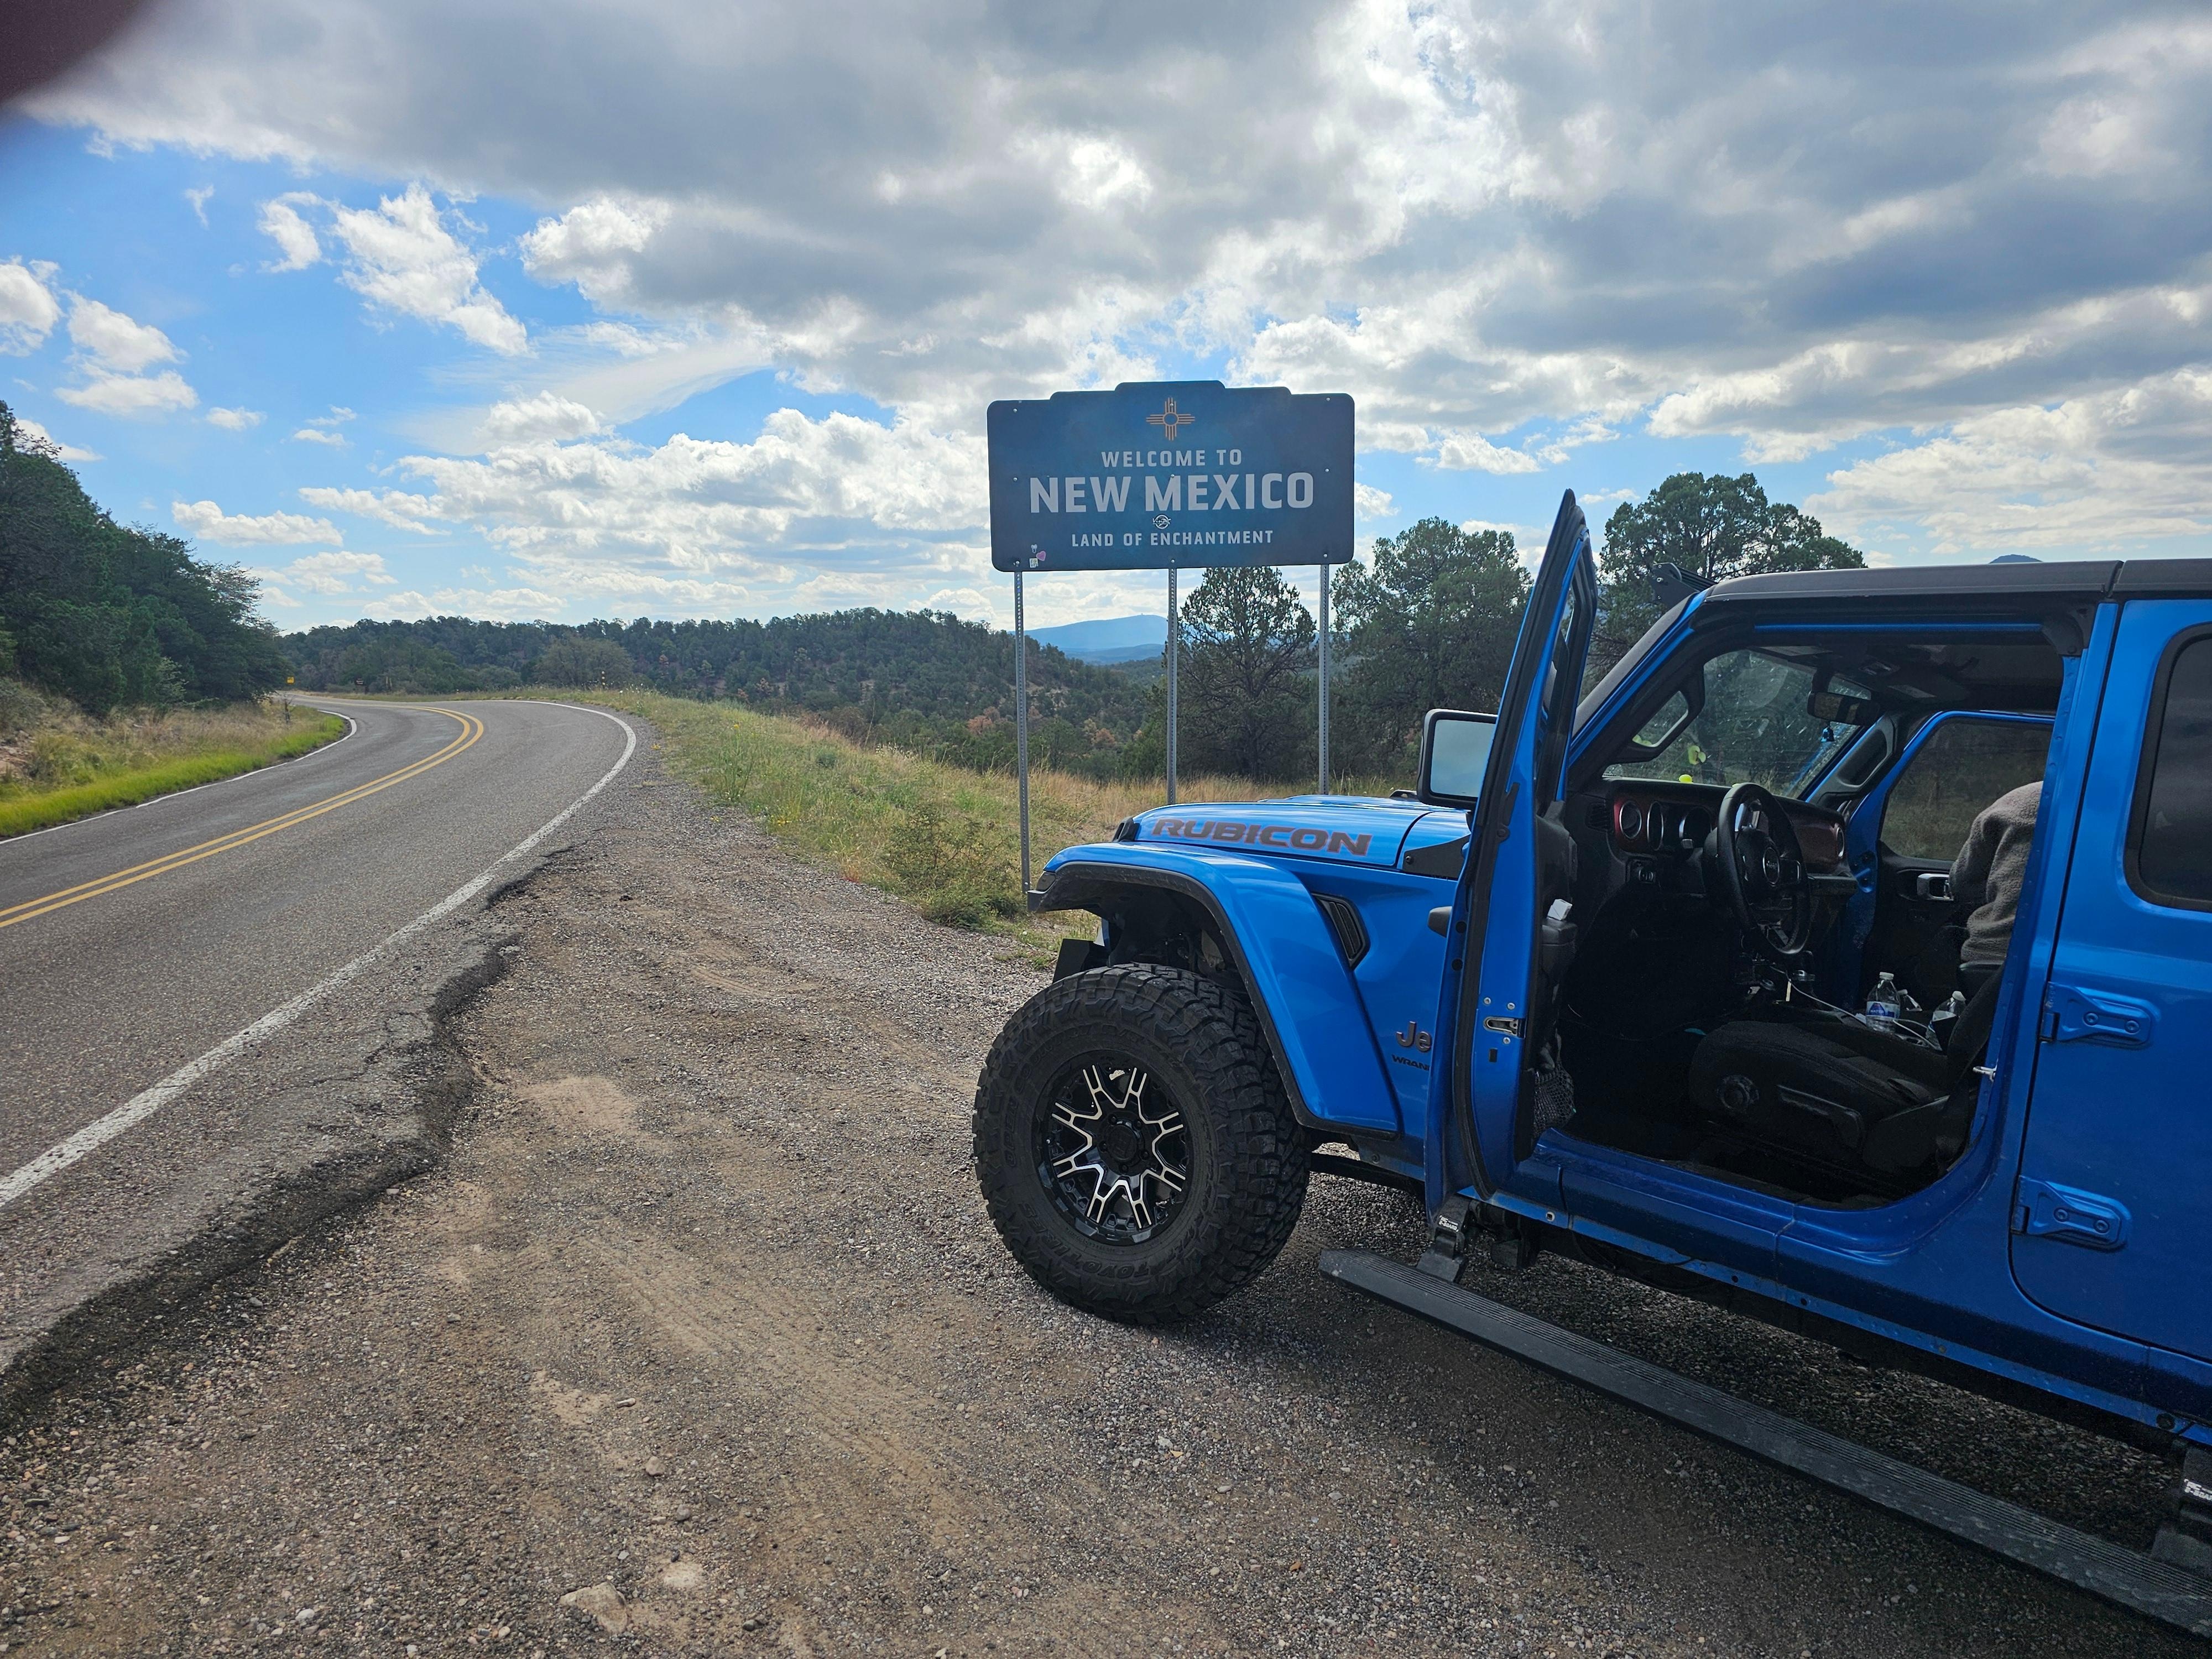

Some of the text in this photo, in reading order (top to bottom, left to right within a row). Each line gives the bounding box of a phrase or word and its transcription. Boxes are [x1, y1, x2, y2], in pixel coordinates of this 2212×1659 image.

[1101, 449, 1242, 467] WELCOME TO
[1030, 472, 1313, 513] NEW MEXICO
[1072, 530, 1273, 547] LAND OF ENCHANTMENT
[1152, 818, 1372, 856] RUBICON
[1001, 1094, 1023, 1169] OPEN
[1017, 1197, 1082, 1271] TIRES
[1081, 1258, 1150, 1280] TOYO
